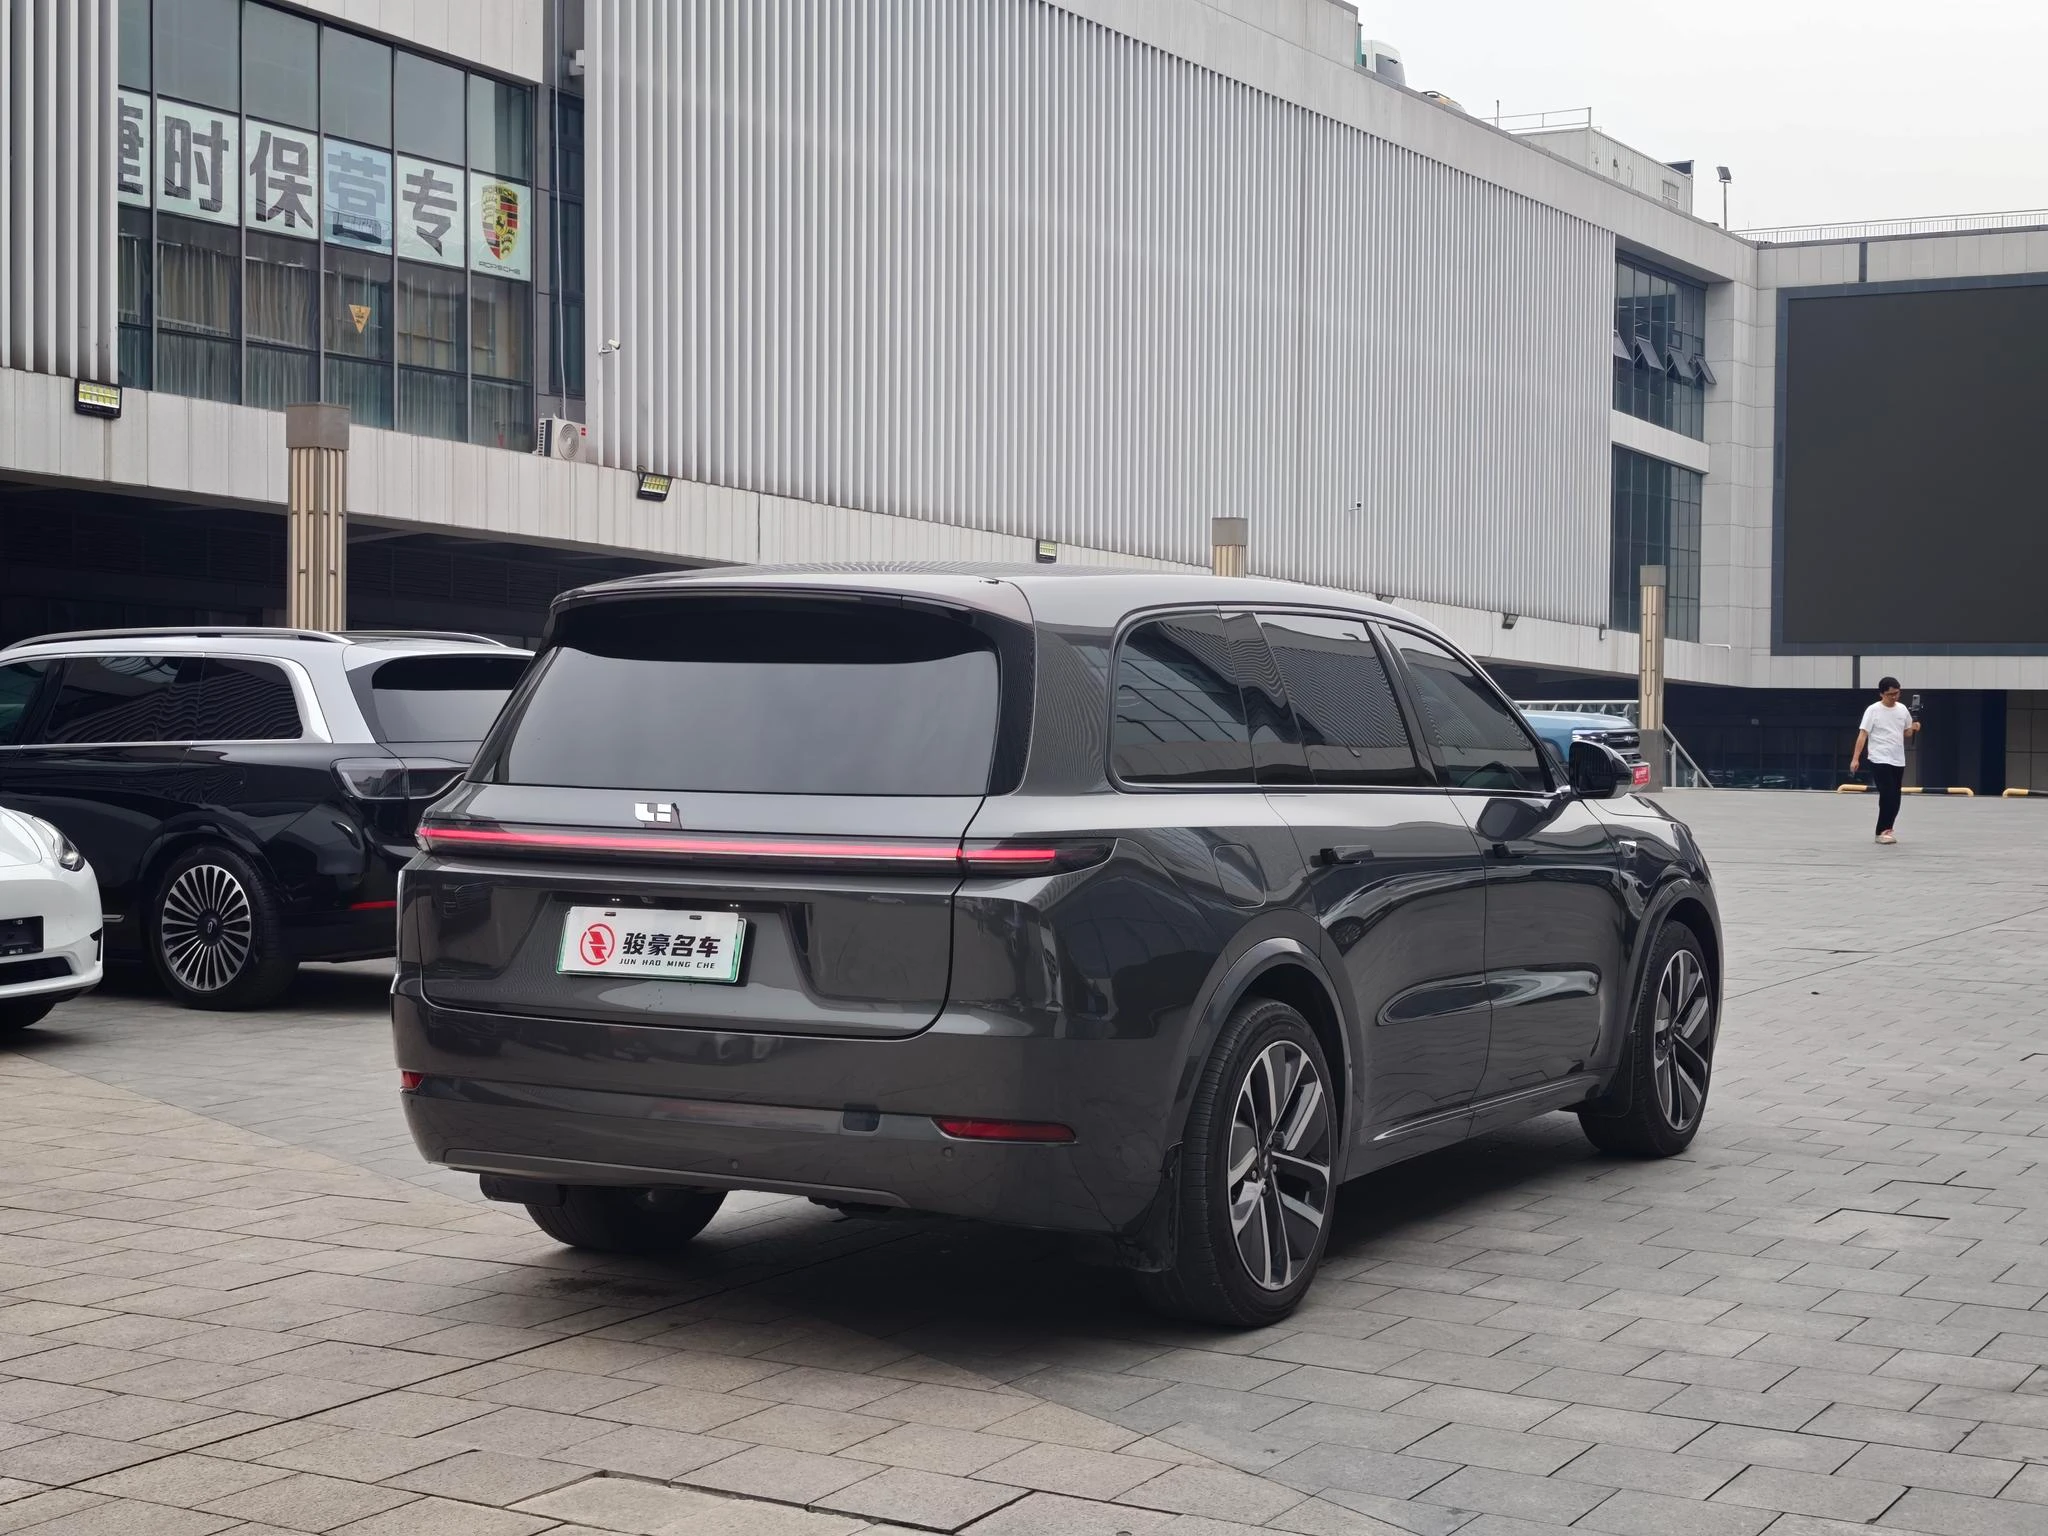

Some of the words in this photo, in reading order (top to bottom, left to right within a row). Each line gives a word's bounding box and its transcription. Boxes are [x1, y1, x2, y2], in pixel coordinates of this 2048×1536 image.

[622, 932, 721, 958] 骏豪名车
[619, 958, 637, 967] JUN
[641, 959, 662, 967] HAO
[666, 960, 691, 969] MING
[696, 961, 715, 970] CHE
